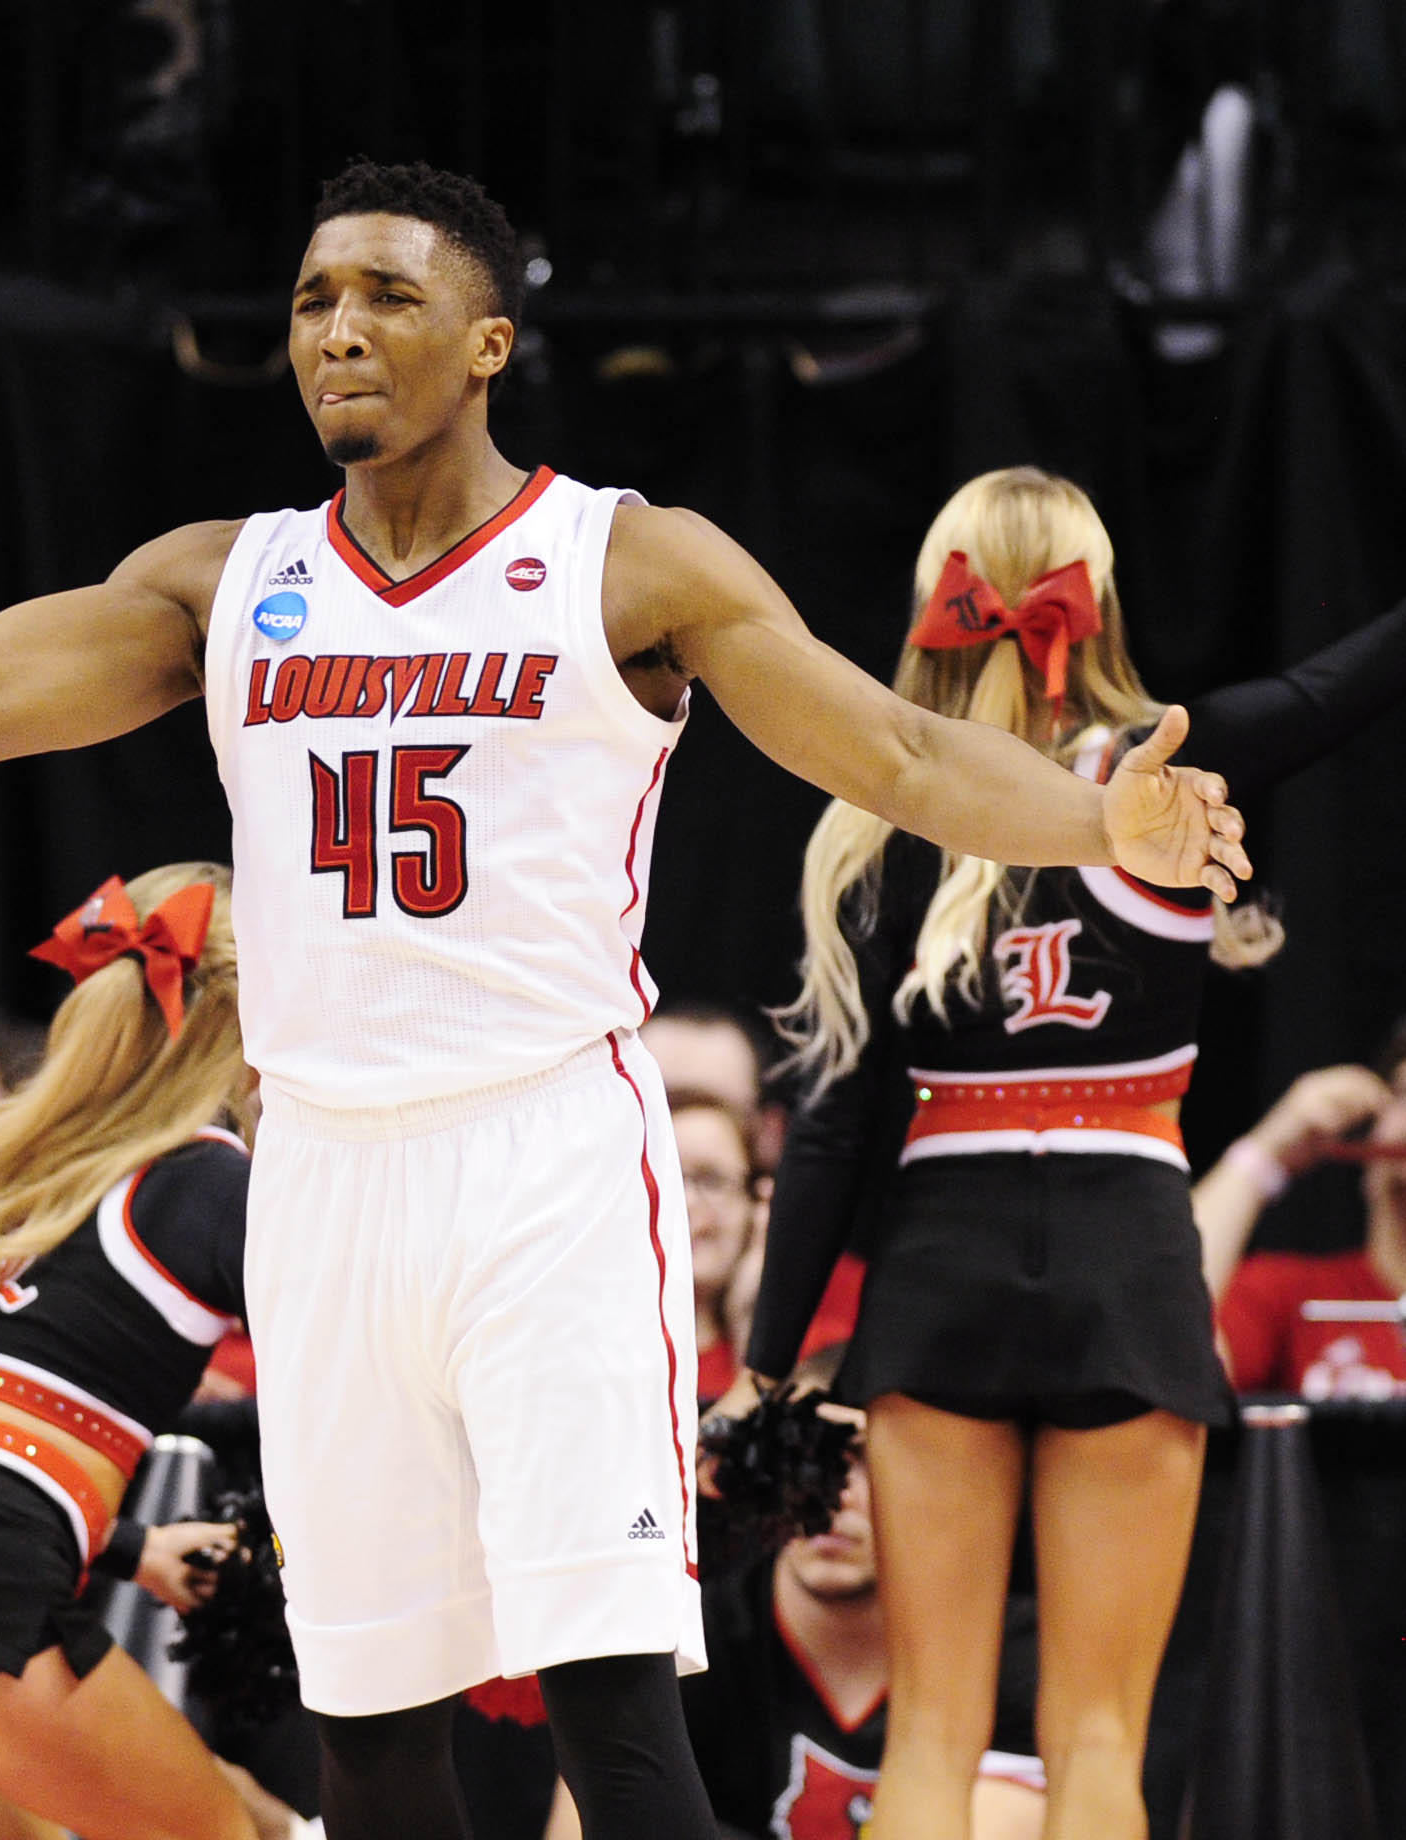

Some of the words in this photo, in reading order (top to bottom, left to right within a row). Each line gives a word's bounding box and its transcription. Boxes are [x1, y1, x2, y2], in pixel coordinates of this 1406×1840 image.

[268, 575, 314, 585] adidas
[505, 567, 546, 580] ACC
[256, 611, 305, 629] NCAA
[243, 652, 559, 728] LOUISVILLE
[308, 744, 472, 919] 45
[993, 918, 1112, 1035] L
[627, 1526, 665, 1539] adidas
